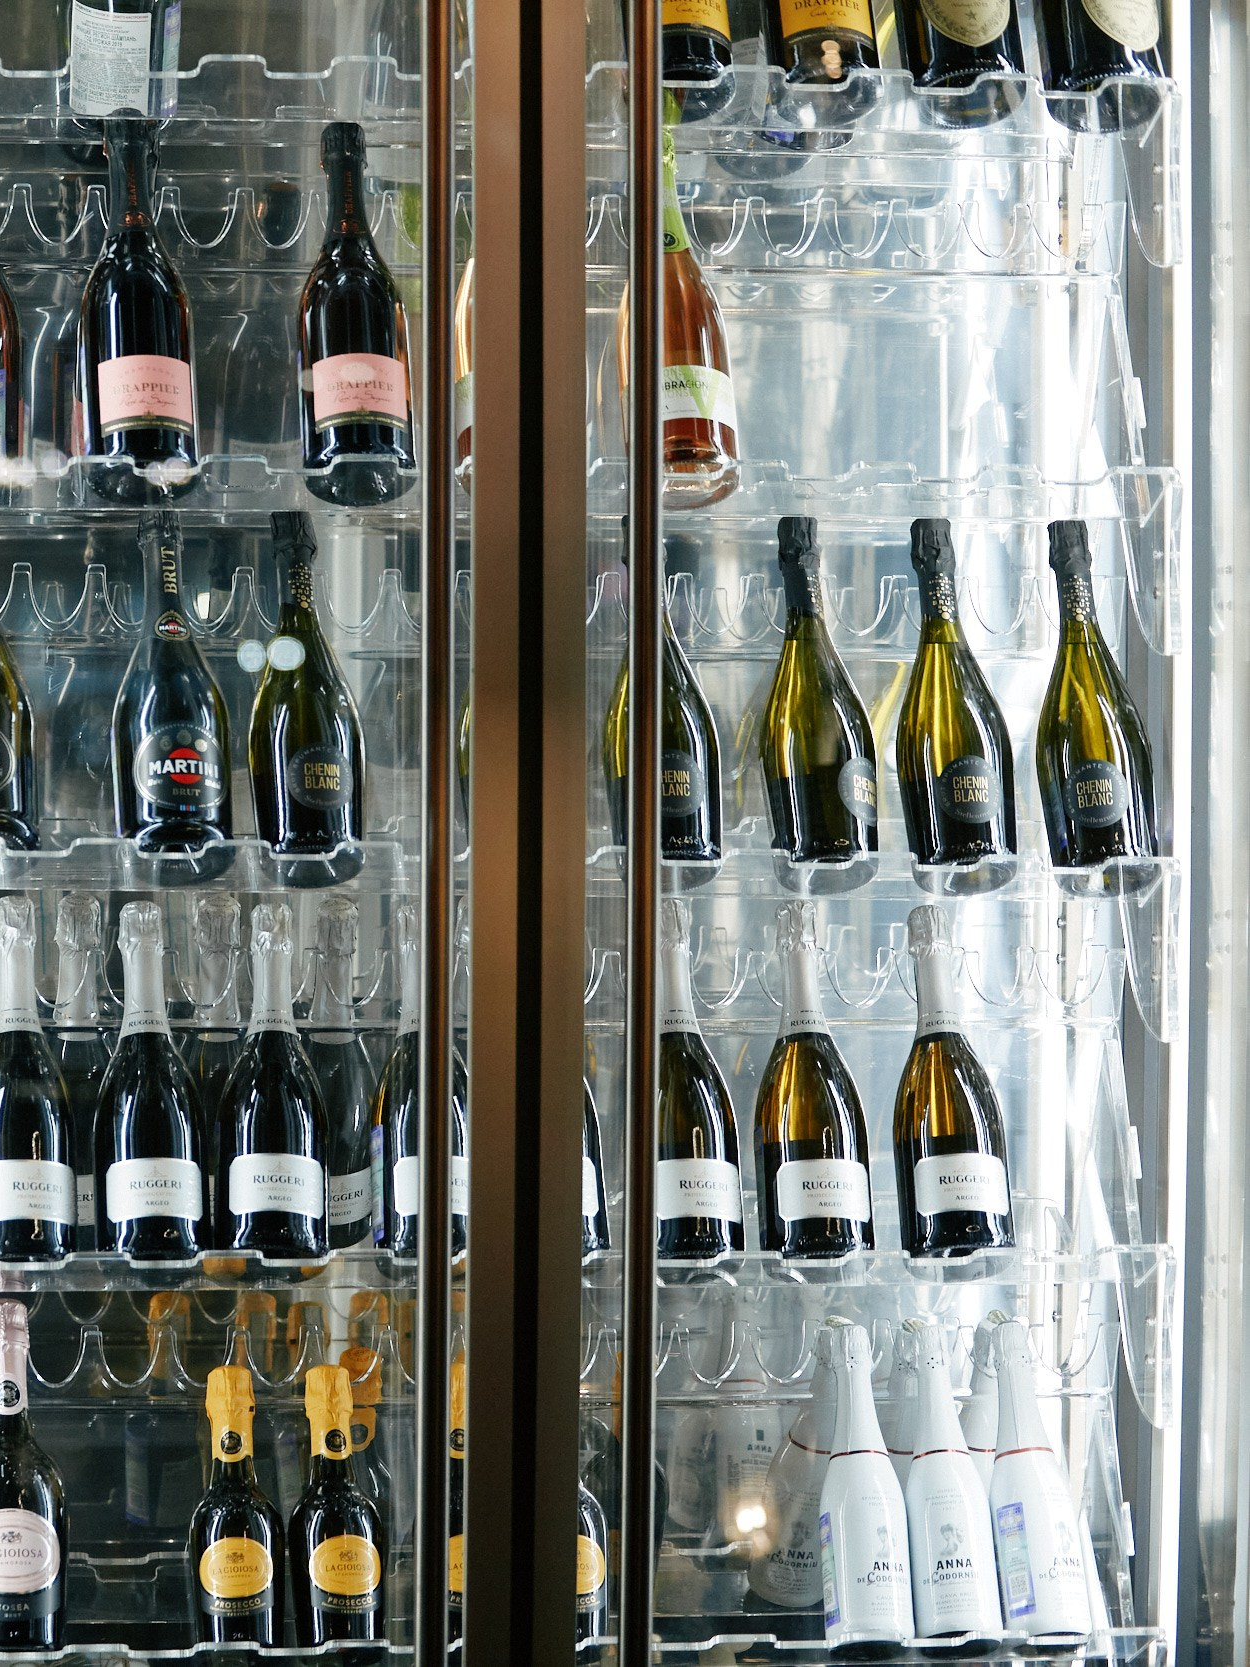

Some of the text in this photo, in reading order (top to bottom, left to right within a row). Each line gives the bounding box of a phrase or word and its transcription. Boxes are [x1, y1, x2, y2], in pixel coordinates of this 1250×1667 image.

[161, 546, 177, 594] BRUT
[159, 625, 186, 633] MARTINI
[148, 759, 219, 779] MARTINI
[304, 763, 340, 778] CHENIN
[662, 770, 690, 783] HENIN
[953, 776, 988, 789] CHENIN
[305, 776, 340, 791] BLANC
[1077, 778, 1112, 795] CHENIN
[172, 787, 201, 797] BRUT
[662, 784, 690, 797] LANC
[954, 789, 989, 803] BLANC
[1078, 793, 1113, 809] BLANC
[128, 1019, 163, 1027] RUGGERI
[256, 1018, 291, 1026] RUGGERI
[130, 1180, 182, 1190] RUGGERI
[253, 1175, 304, 1187] RUGGERI
[680, 1180, 728, 1191] RUGGERI
[803, 1181, 852, 1190] RUGGERI
[939, 1174, 989, 1185] RUGGERI
[13, 1182, 62, 1194] RUGGERI
[936, 1558, 973, 1570] ANNA
[215, 1597, 261, 1608] PROSECCO
[327, 1596, 372, 1606] PROSECCO
